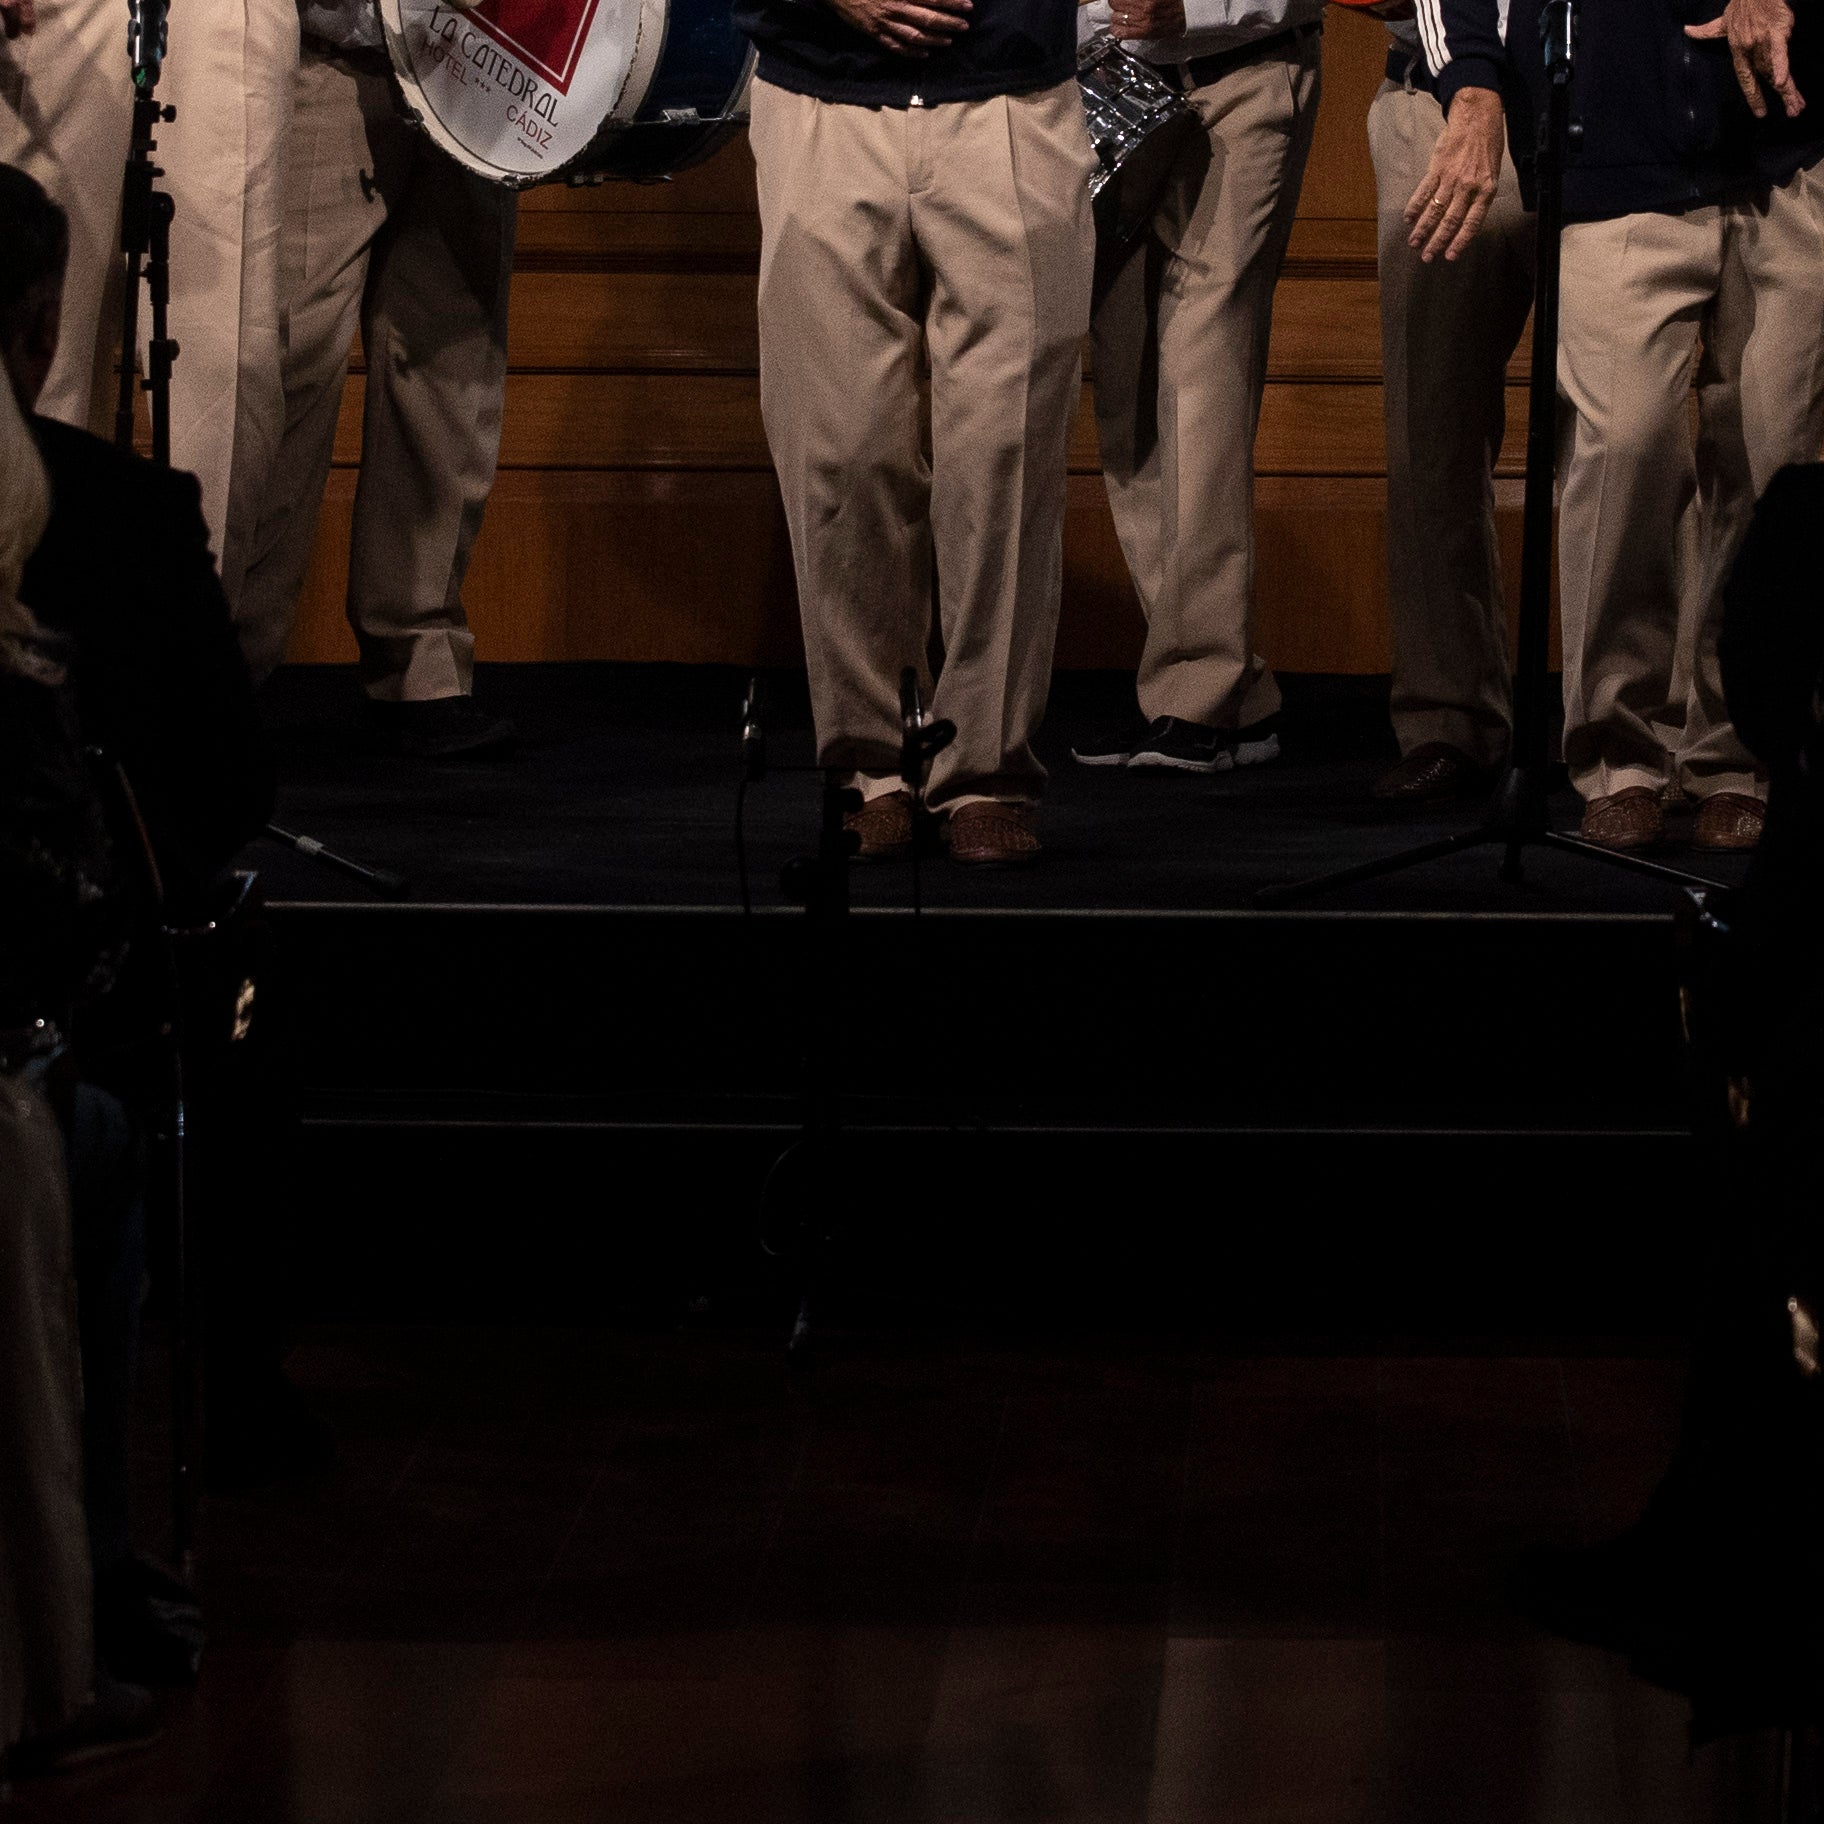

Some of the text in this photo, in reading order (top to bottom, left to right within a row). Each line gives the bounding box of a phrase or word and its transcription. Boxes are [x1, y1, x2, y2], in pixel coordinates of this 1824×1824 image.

[421, 38, 468, 86] HOTEL
[429, 5, 559, 128] LA CATEDRAL
[506, 104, 553, 151] CÁDIZ
